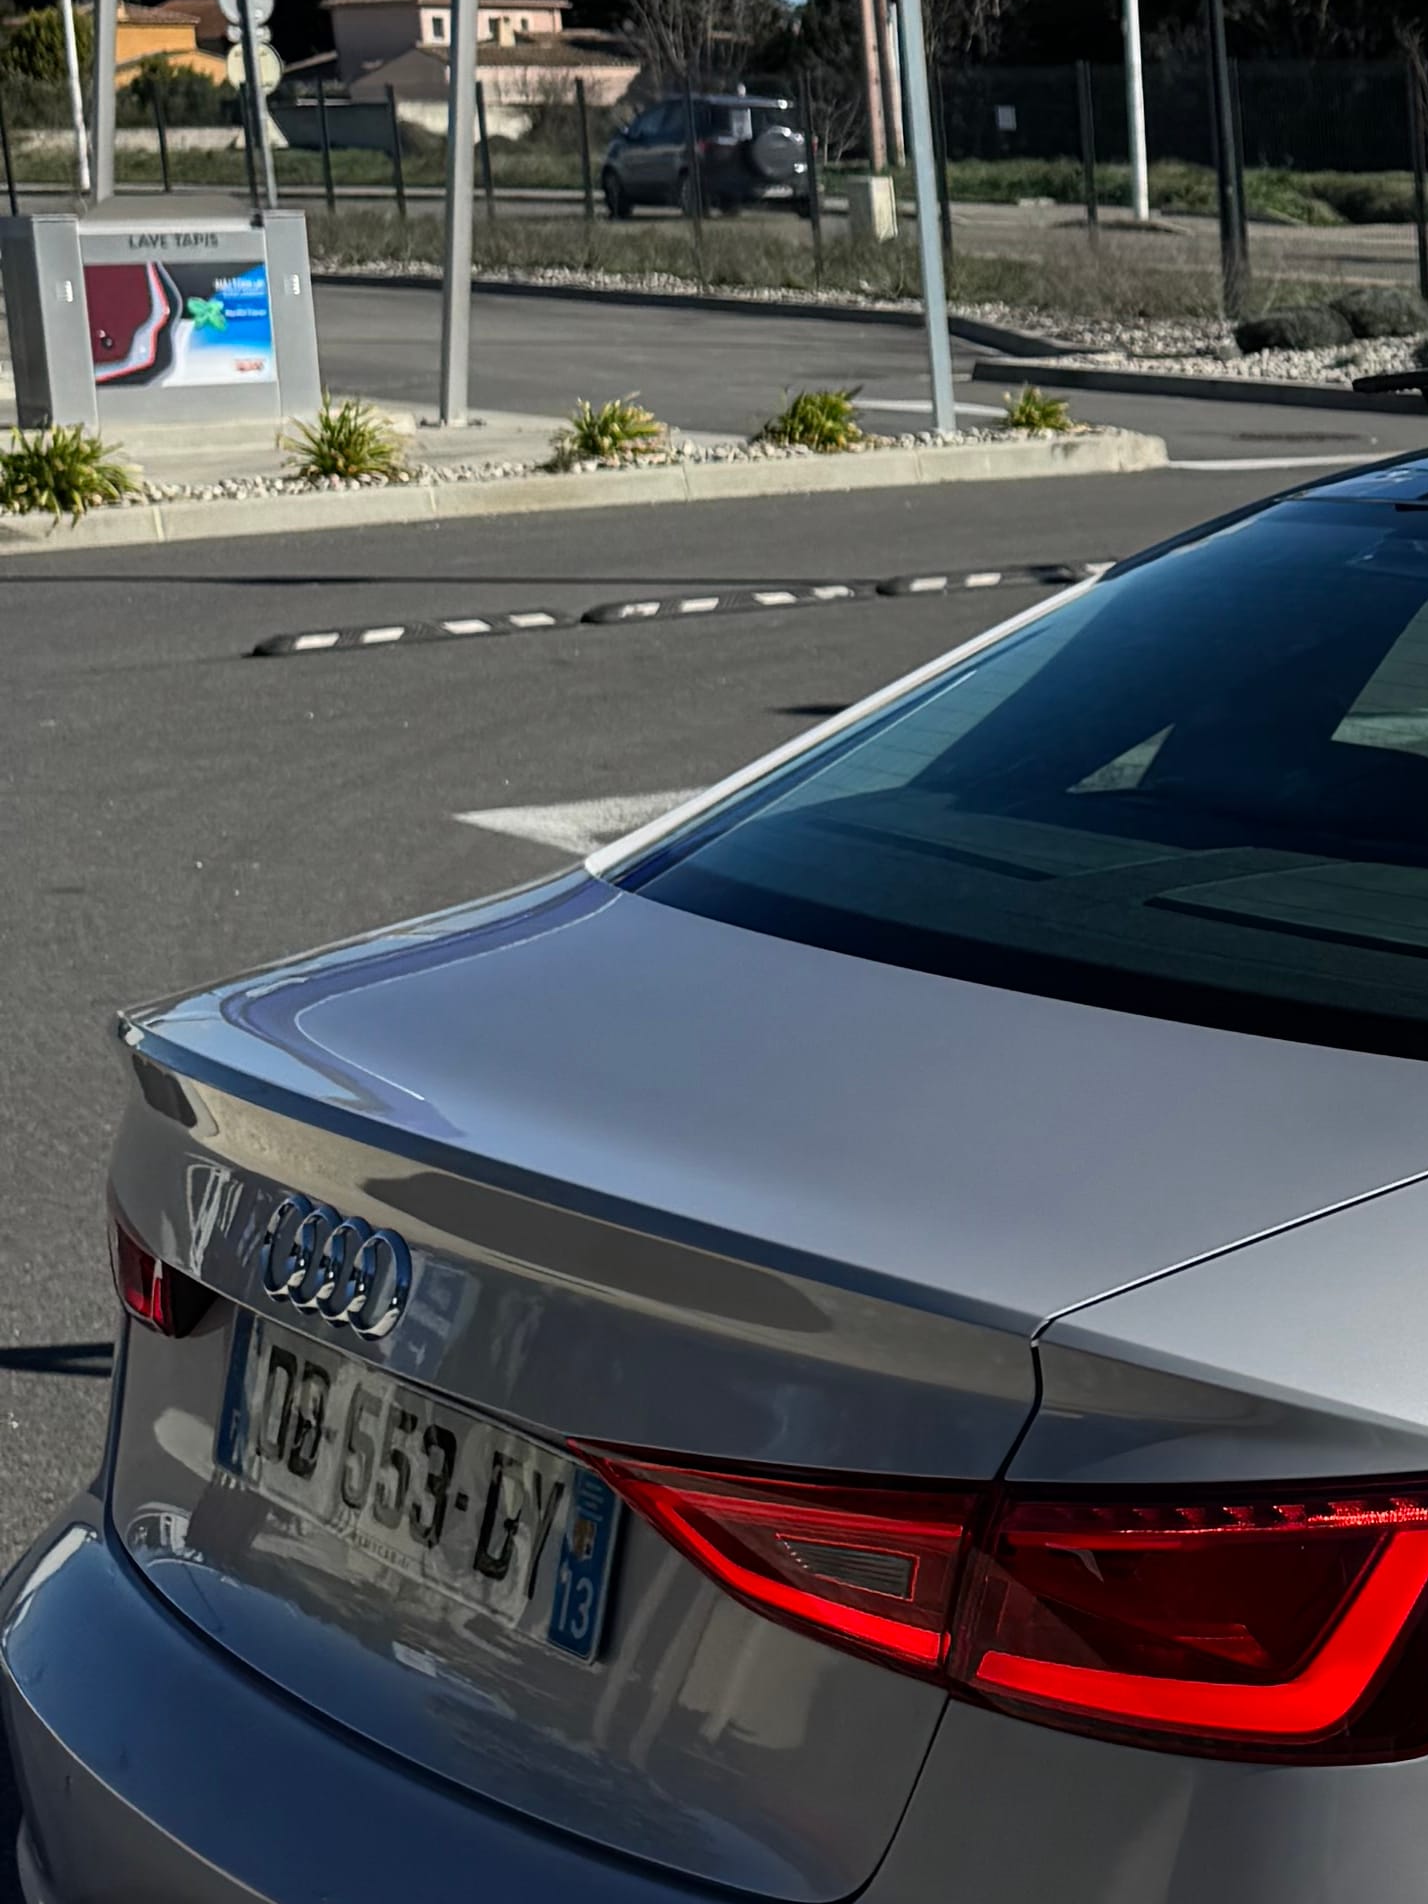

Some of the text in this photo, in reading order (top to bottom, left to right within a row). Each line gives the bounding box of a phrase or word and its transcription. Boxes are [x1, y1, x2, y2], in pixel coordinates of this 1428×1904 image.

[128, 231, 219, 250] LAVE TAPIS
[556, 1562, 595, 1641] 13
